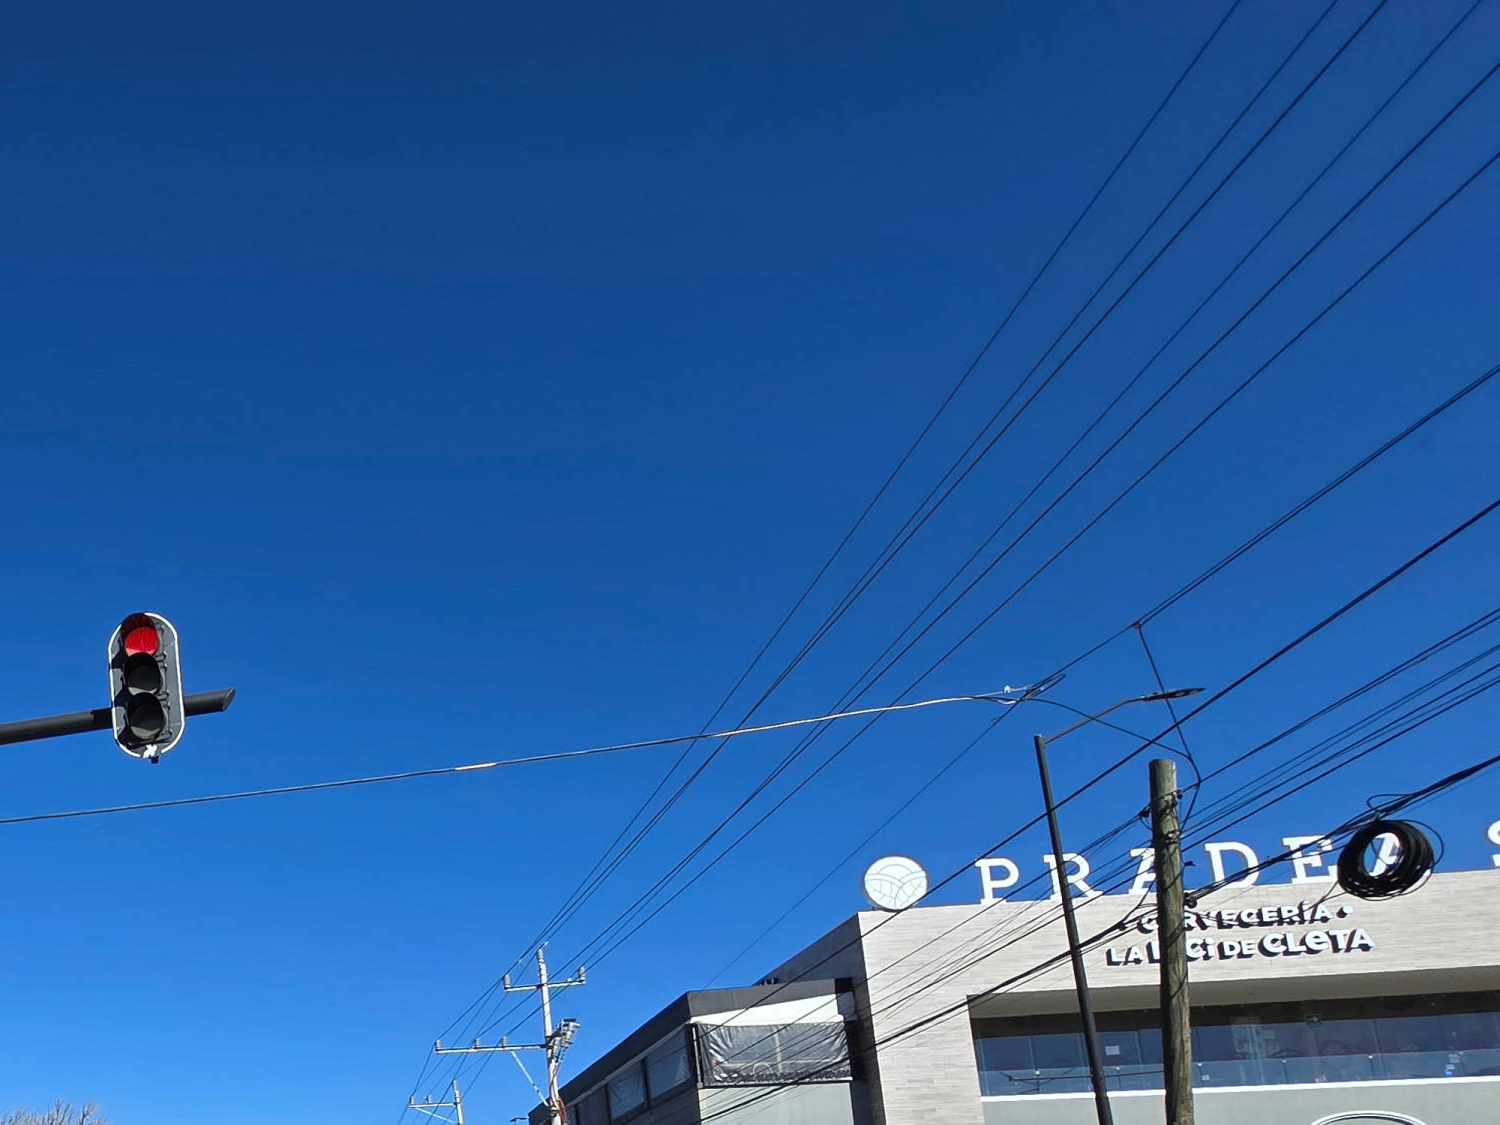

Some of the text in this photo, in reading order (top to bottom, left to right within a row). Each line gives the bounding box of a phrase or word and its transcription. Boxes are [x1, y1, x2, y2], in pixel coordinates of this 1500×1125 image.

[1138, 901, 1333, 934] CRVECERÍA
[1107, 945, 1145, 966] LA
[1219, 939, 1256, 960] DE
